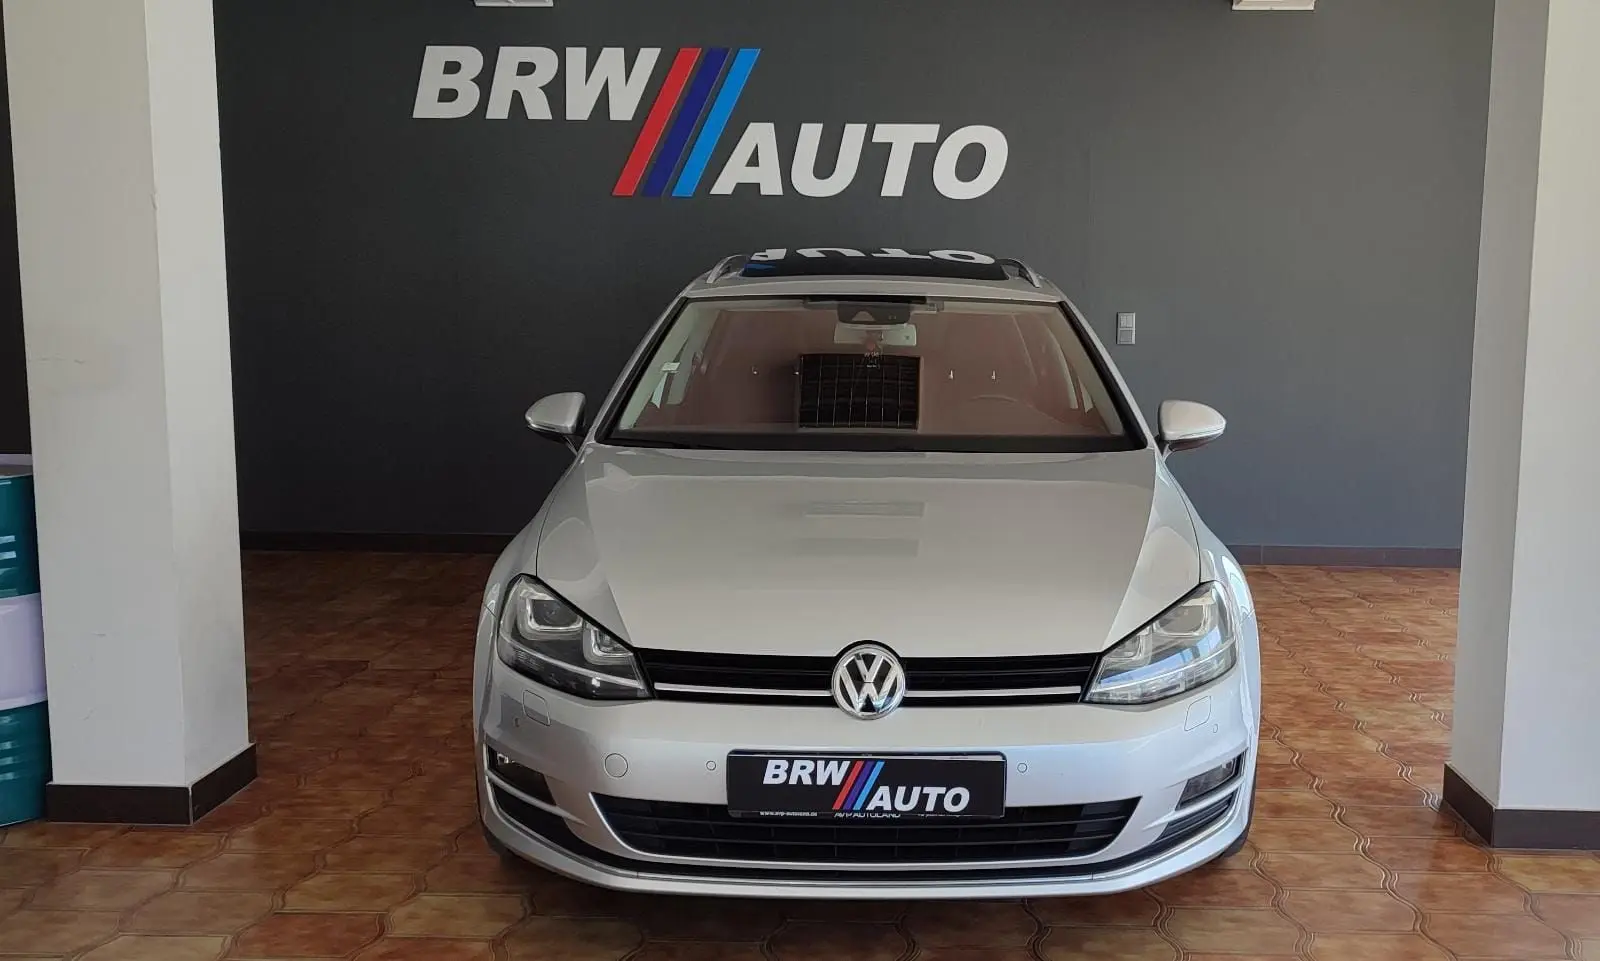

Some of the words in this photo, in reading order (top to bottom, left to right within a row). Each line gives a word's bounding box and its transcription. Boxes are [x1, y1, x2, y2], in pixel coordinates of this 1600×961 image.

[412, 45, 661, 121] BRW
[709, 122, 1009, 200] AUTO
[762, 759, 851, 785] BRW
[865, 786, 970, 812] AUTO
